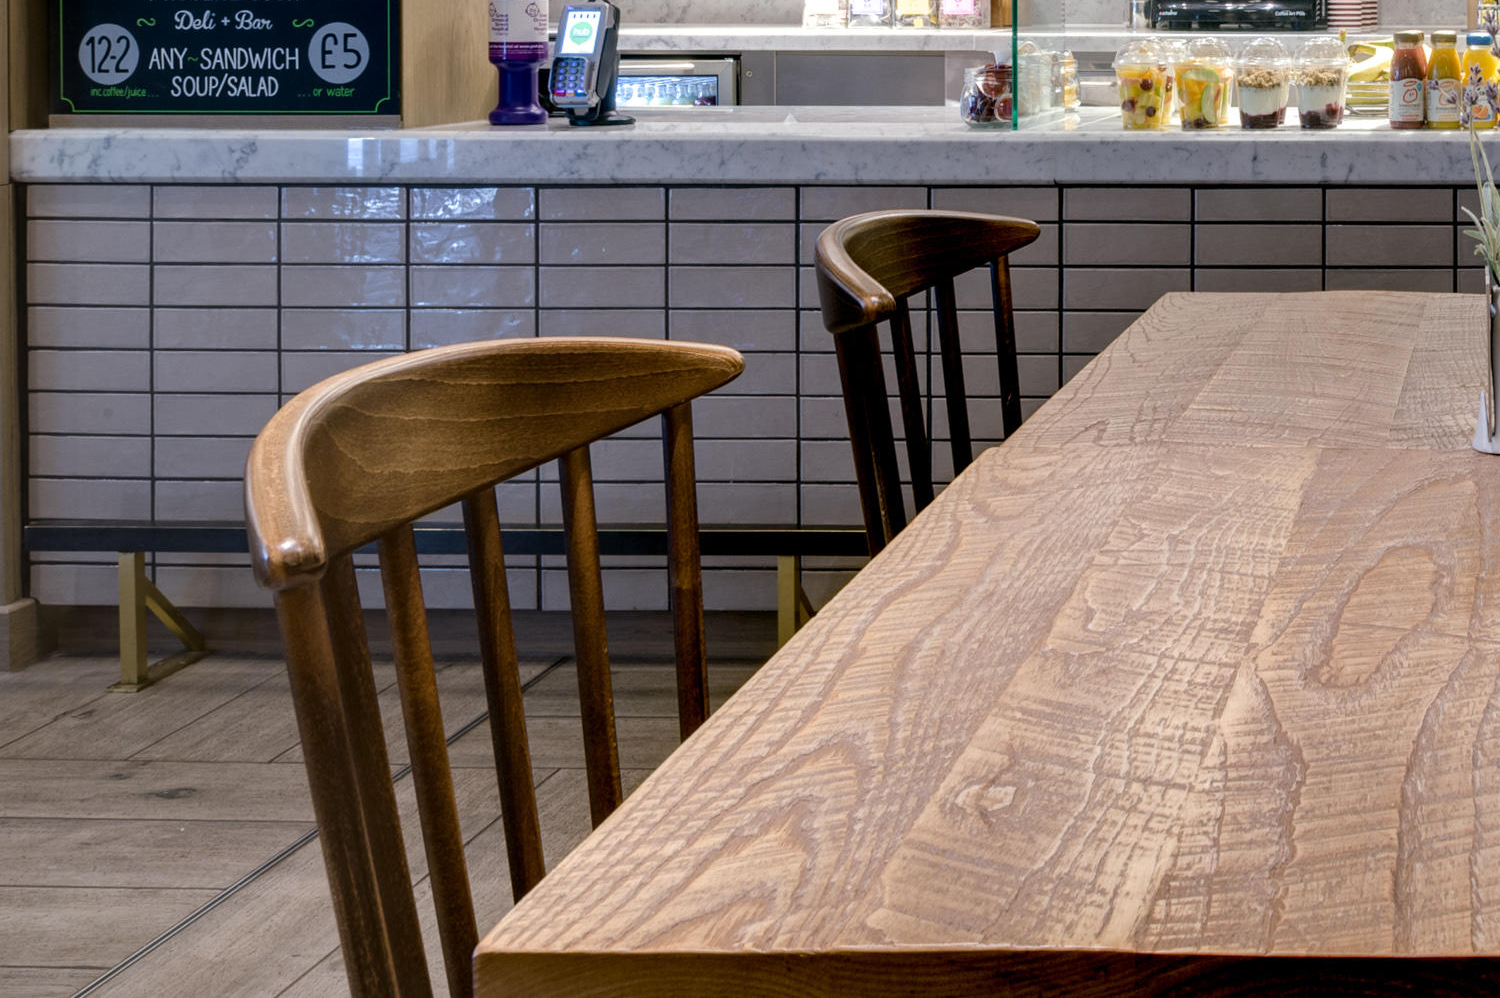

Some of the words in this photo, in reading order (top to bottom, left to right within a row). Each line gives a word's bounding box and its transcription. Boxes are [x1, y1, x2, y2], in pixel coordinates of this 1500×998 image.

[174, 10, 215, 31] Deli
[235, 10, 273, 31] Bar
[149, 48, 186, 70] ANY
[200, 48, 299, 70] SANDWICH
[321, 33, 362, 70] £5
[171, 75, 279, 98] SOUP/SALAD
[326, 87, 356, 97] water
